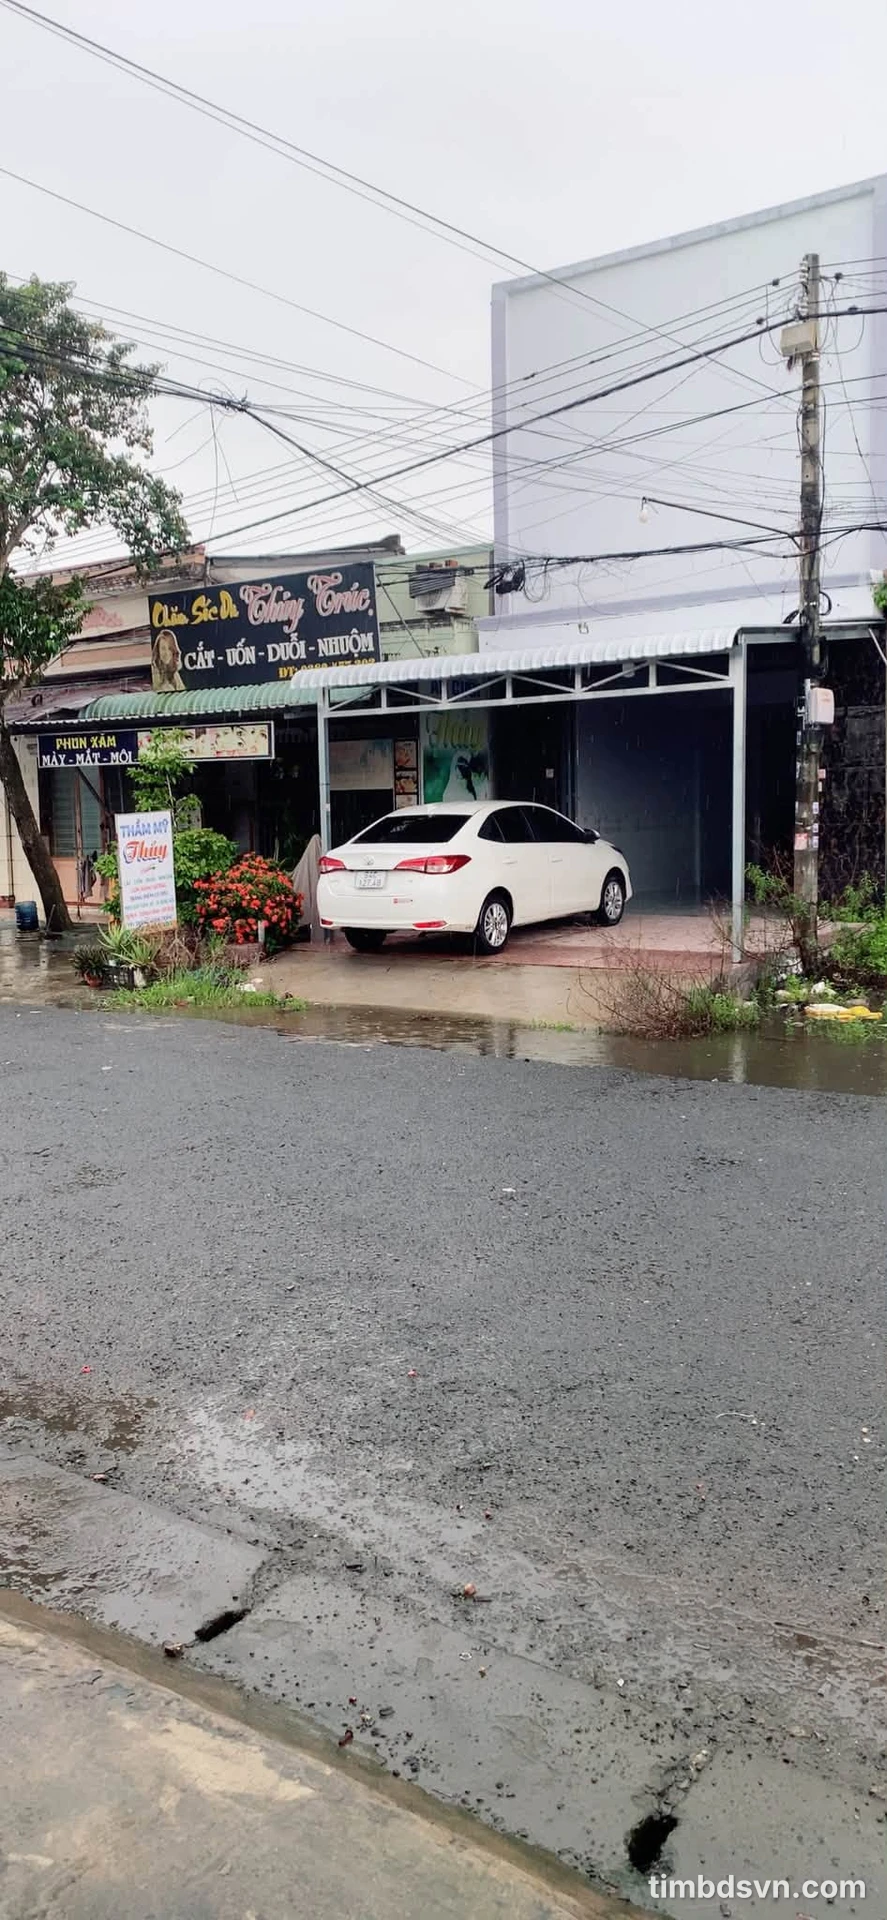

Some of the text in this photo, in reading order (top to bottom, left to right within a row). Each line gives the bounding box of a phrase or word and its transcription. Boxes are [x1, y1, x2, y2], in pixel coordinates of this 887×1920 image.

[184, 641, 215, 669] CẮT
[225, 637, 256, 666] UỐN
[266, 632, 306, 662] DUỖI
[317, 628, 374, 657] NHUỘM
[55, 736, 88, 750] PHUN
[75, 748, 101, 765] MẮT
[110, 748, 133, 764] MÔI
